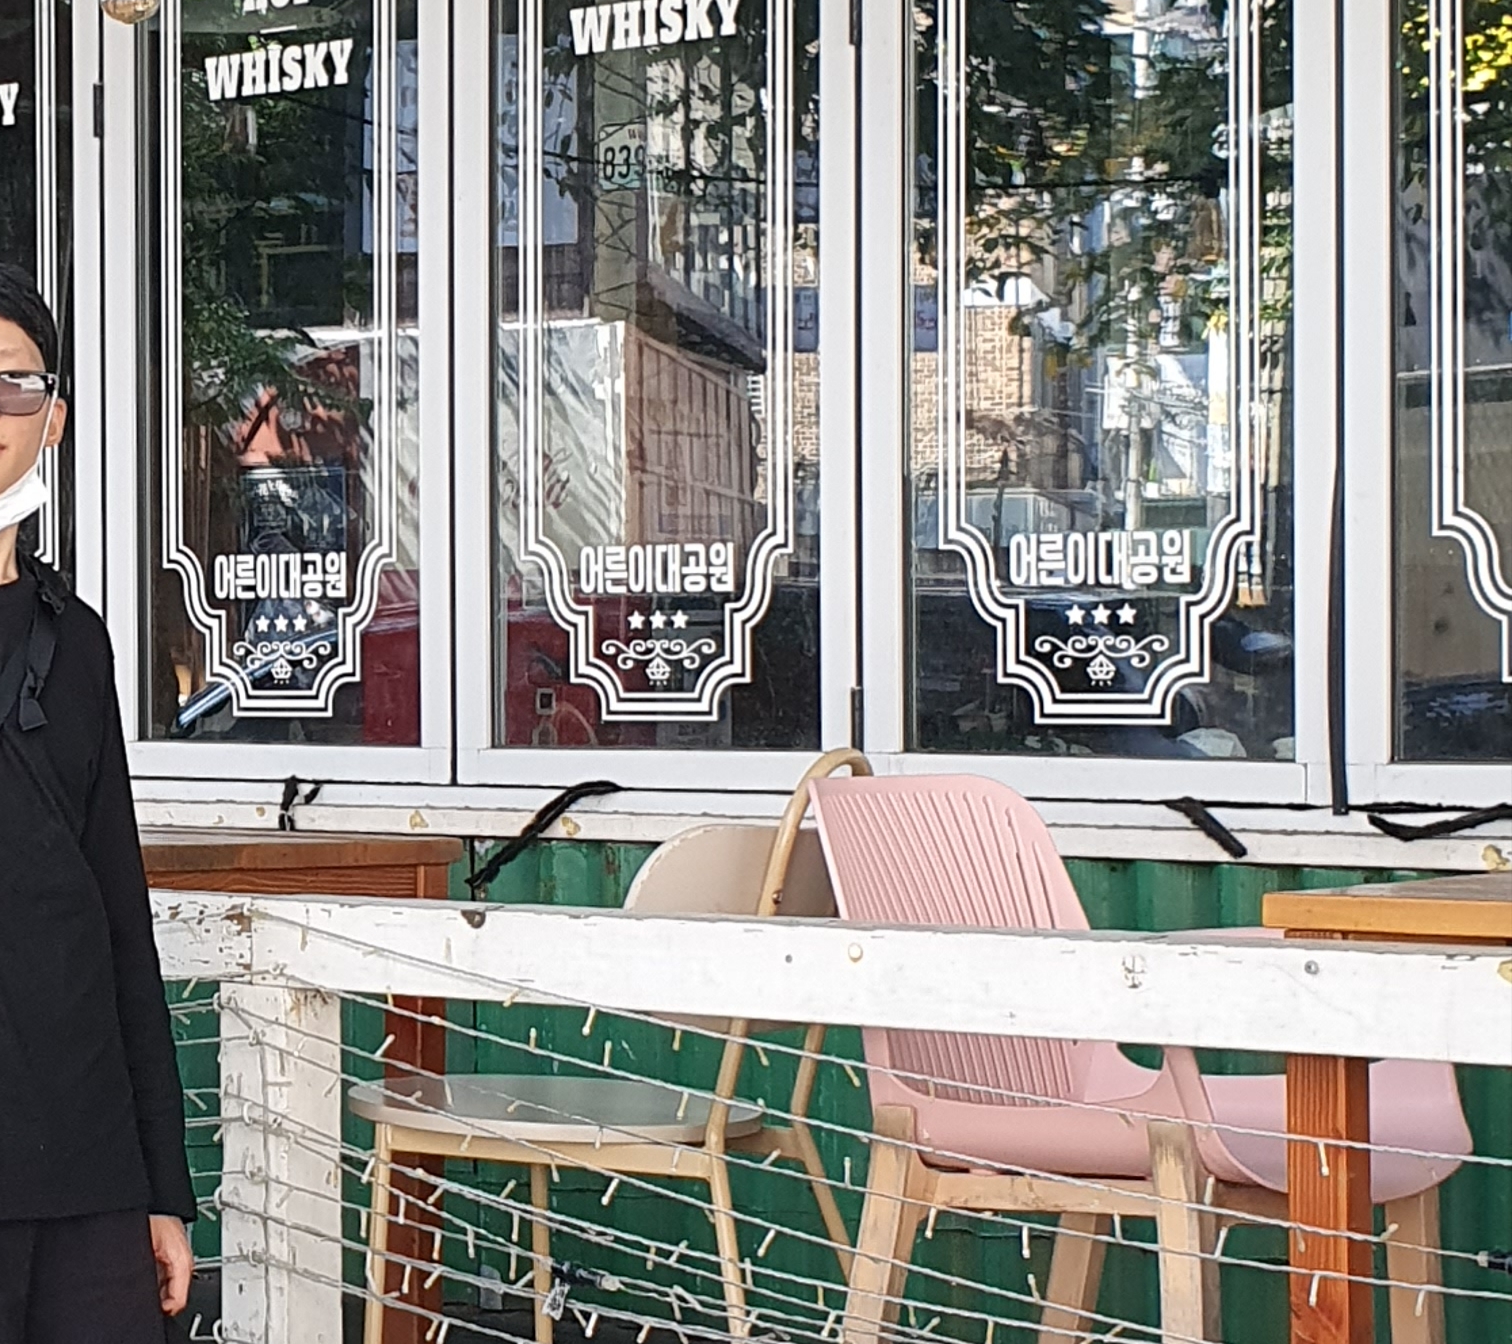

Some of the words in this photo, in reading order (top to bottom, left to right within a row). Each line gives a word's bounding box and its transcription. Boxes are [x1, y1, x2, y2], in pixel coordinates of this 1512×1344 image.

[204, 39, 354, 101] WHISKY
[214, 551, 347, 600] 어른이대공원
[579, 541, 735, 595] 어른이대공원
[1009, 529, 1191, 589] 어른이대공원
